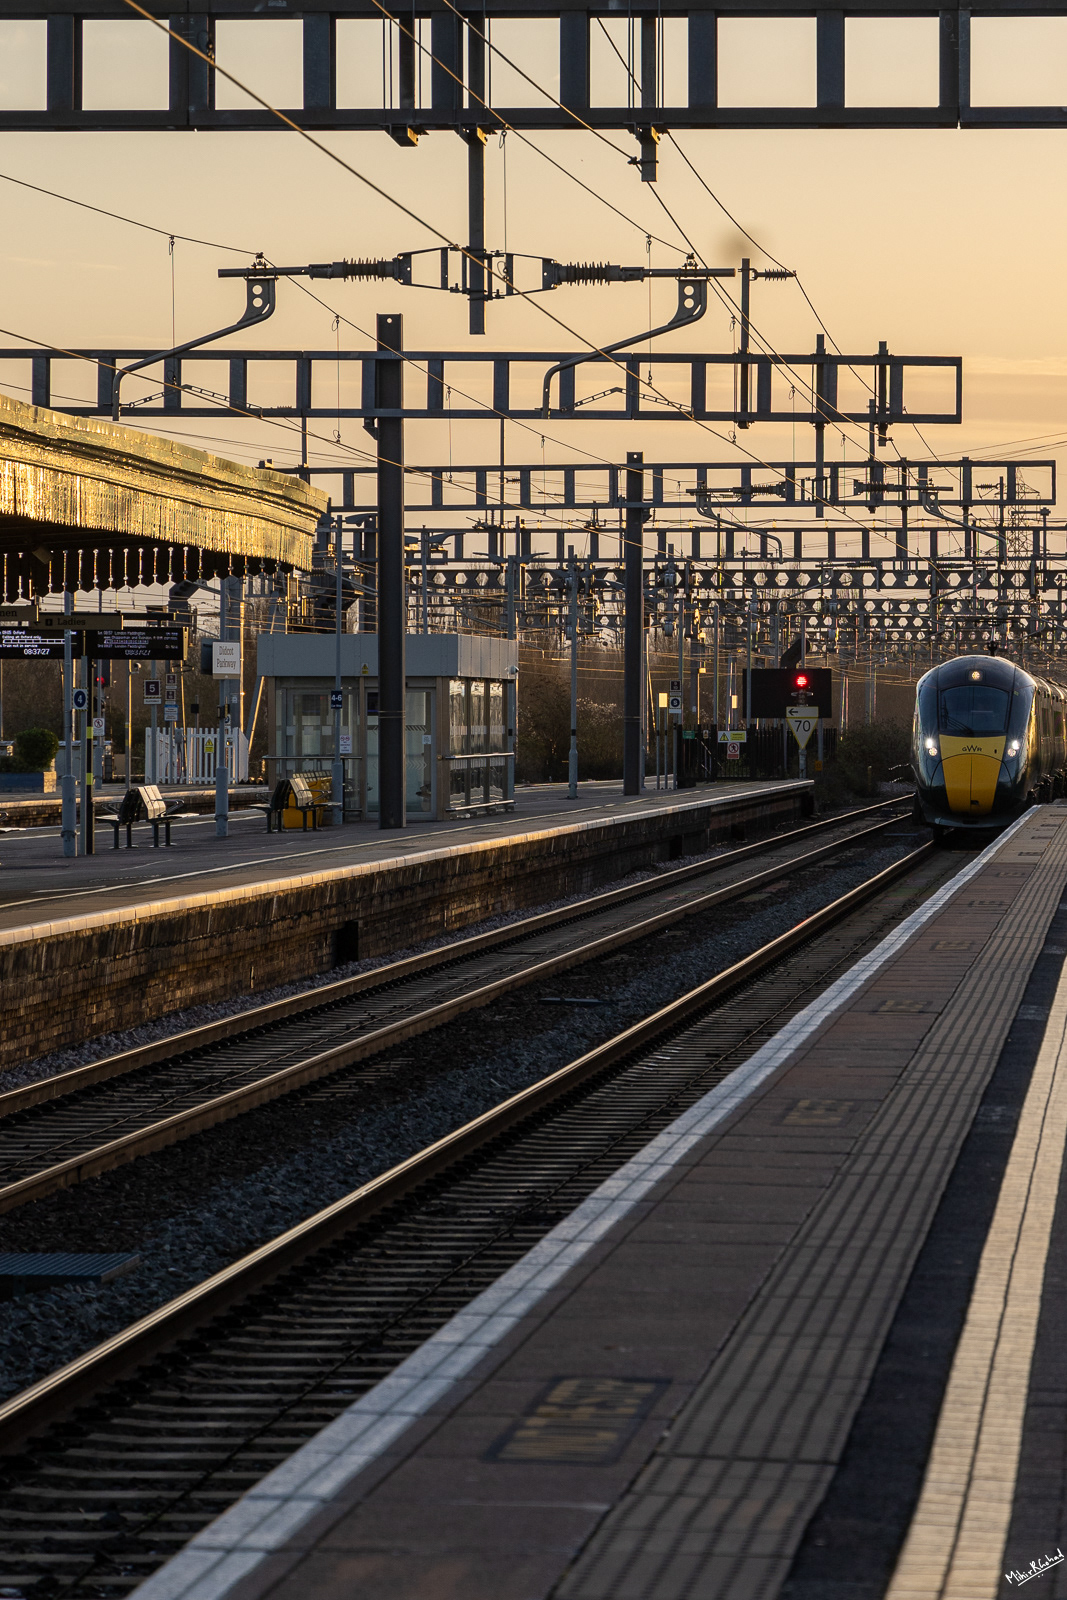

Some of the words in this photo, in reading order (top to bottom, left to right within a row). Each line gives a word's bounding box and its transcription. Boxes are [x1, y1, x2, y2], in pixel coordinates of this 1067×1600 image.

[57, 617, 86, 626] Ladies
[219, 646, 234, 655] Didcot
[217, 658, 236, 669] Parkway
[149, 684, 156, 693] 5
[77, 694, 82, 704] 4
[331, 694, 343, 702] 4-6
[794, 720, 811, 732] 70
[962, 744, 982, 752] GWR
